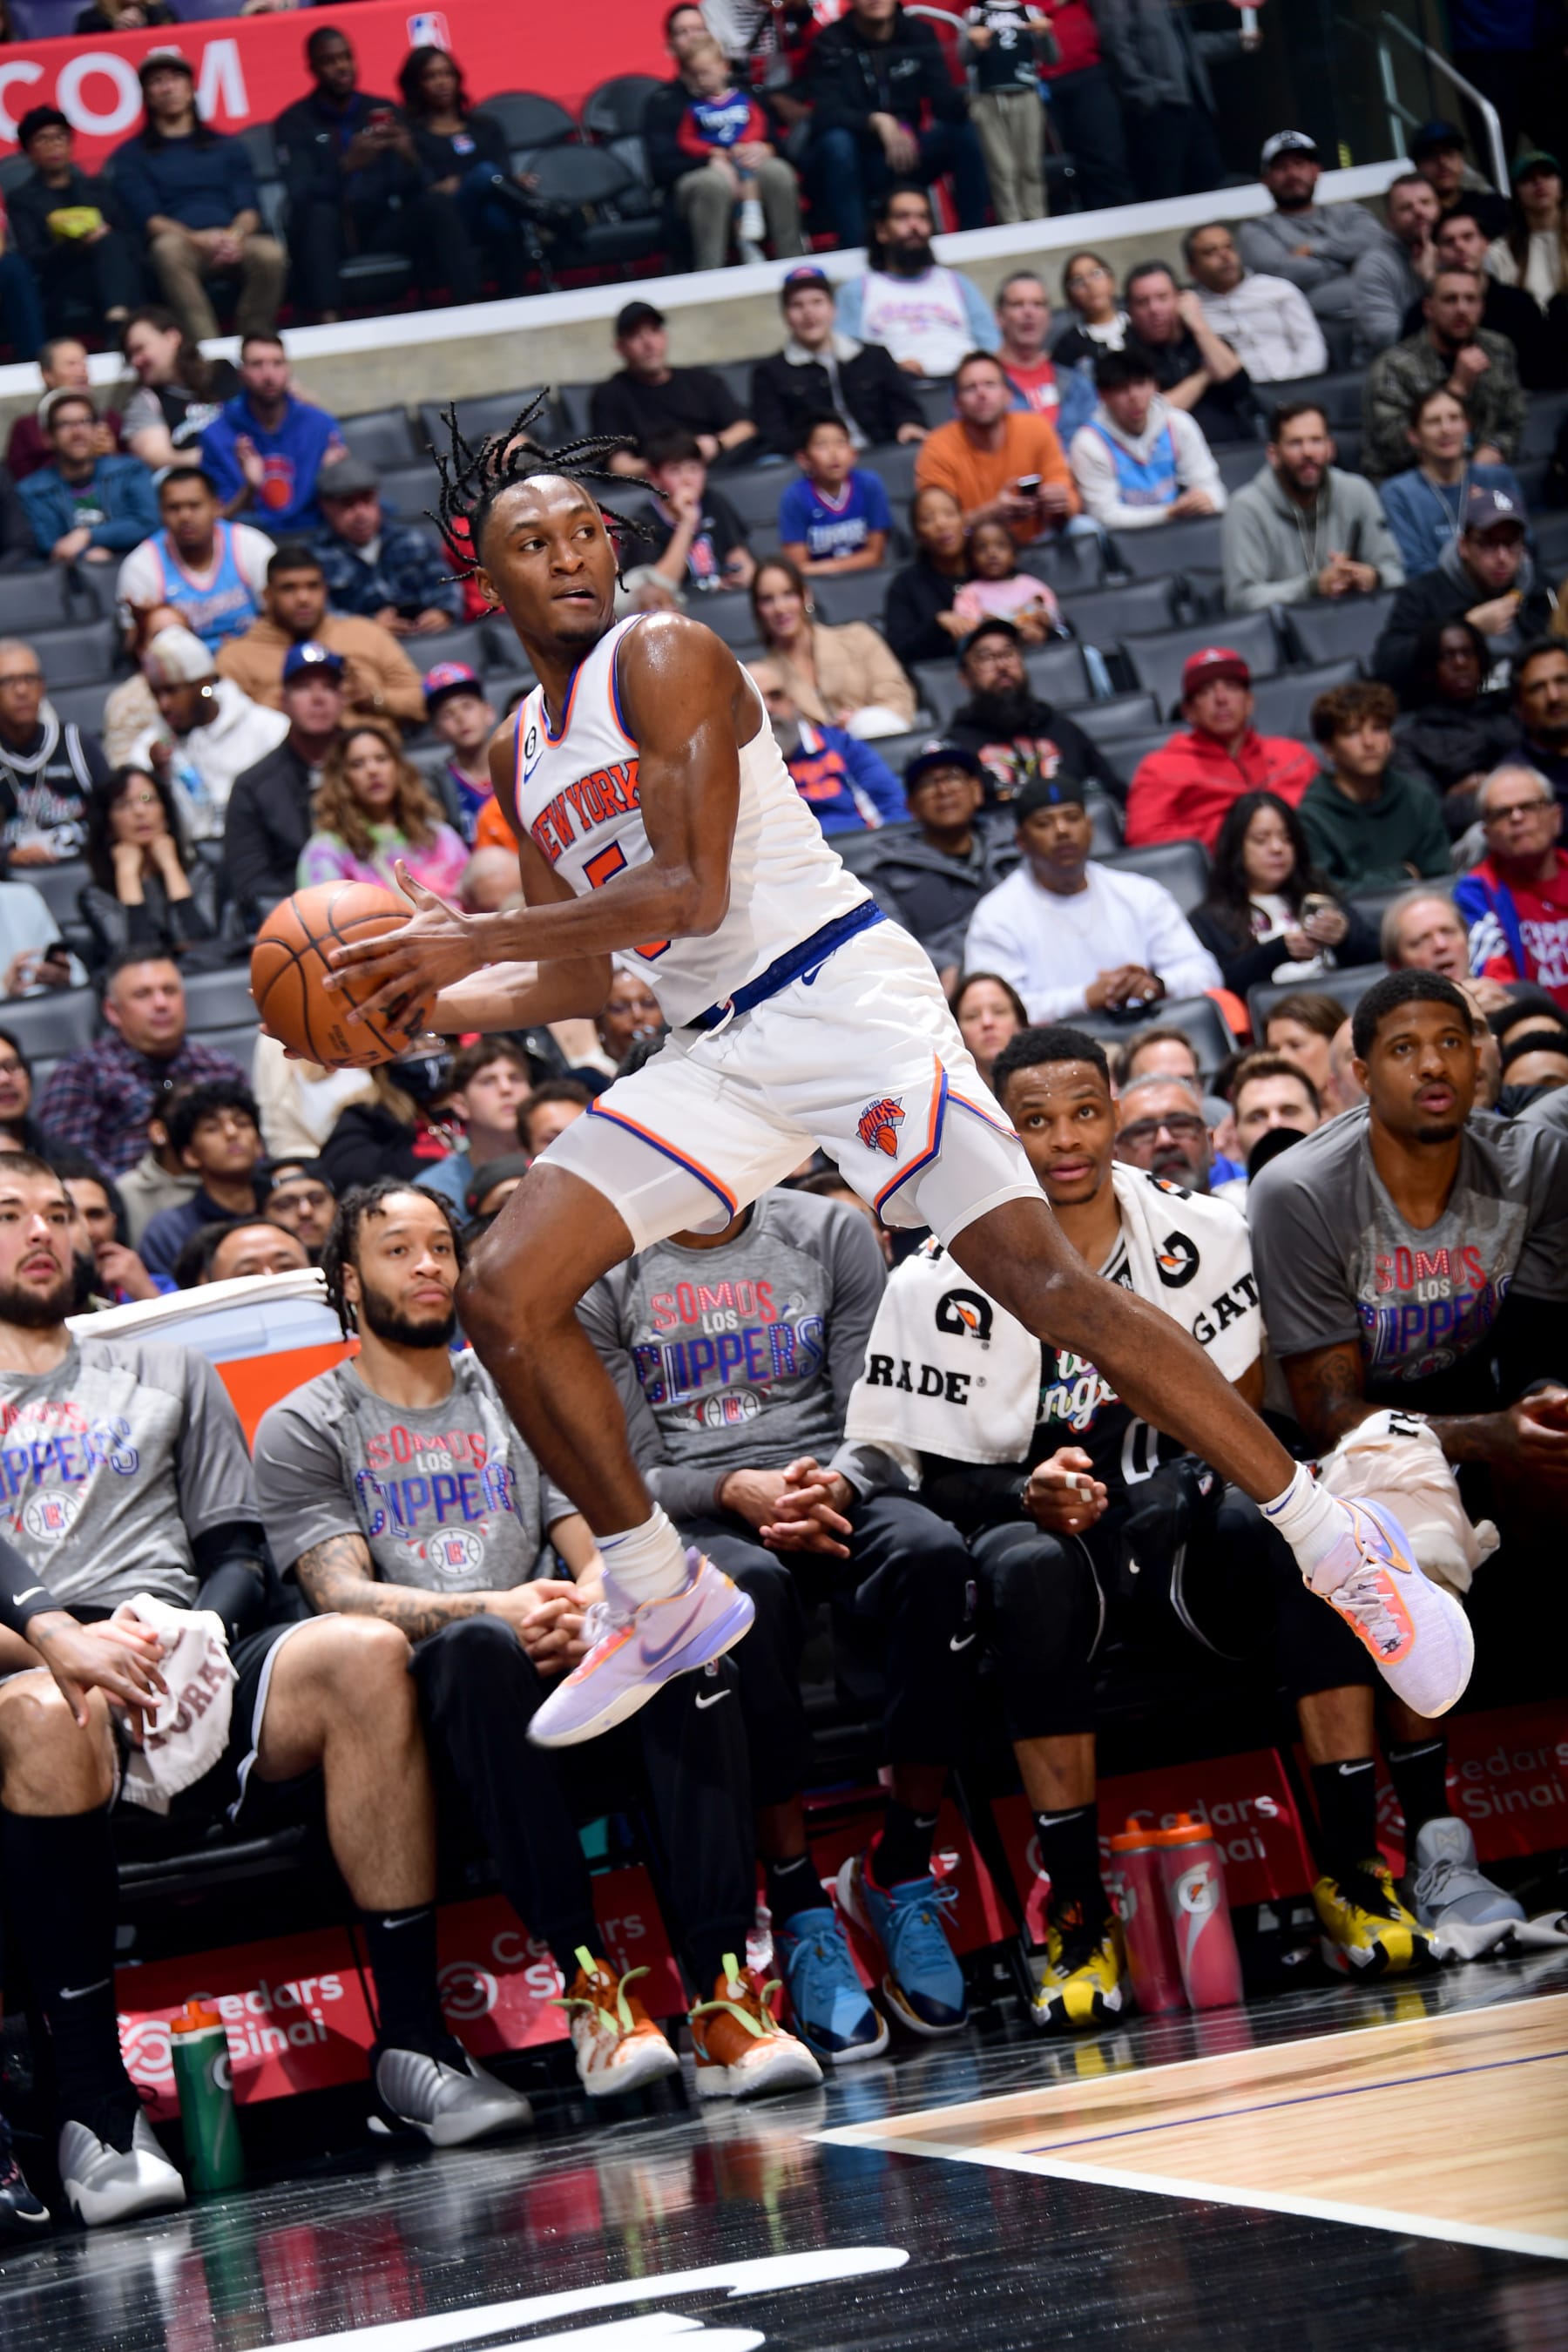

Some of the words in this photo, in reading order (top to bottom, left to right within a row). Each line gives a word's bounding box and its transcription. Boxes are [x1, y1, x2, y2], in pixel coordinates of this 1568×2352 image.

[530, 793, 578, 867] NEW
[564, 758, 642, 834] YORK
[1375, 1246, 1486, 1294] SOMOS
[1417, 1279, 1450, 1301] LOS
[651, 1280, 777, 1330] SOMOS
[702, 1309, 738, 1335] LOS
[633, 1315, 823, 1404] CLIPPERS
[866, 1354, 971, 1405] RADE
[366, 1424, 488, 1470] SOMOS
[416, 1452, 455, 1474] LOS
[1462, 1774, 1566, 1819] Sinai
[226, 2008, 328, 2061] Sinai
